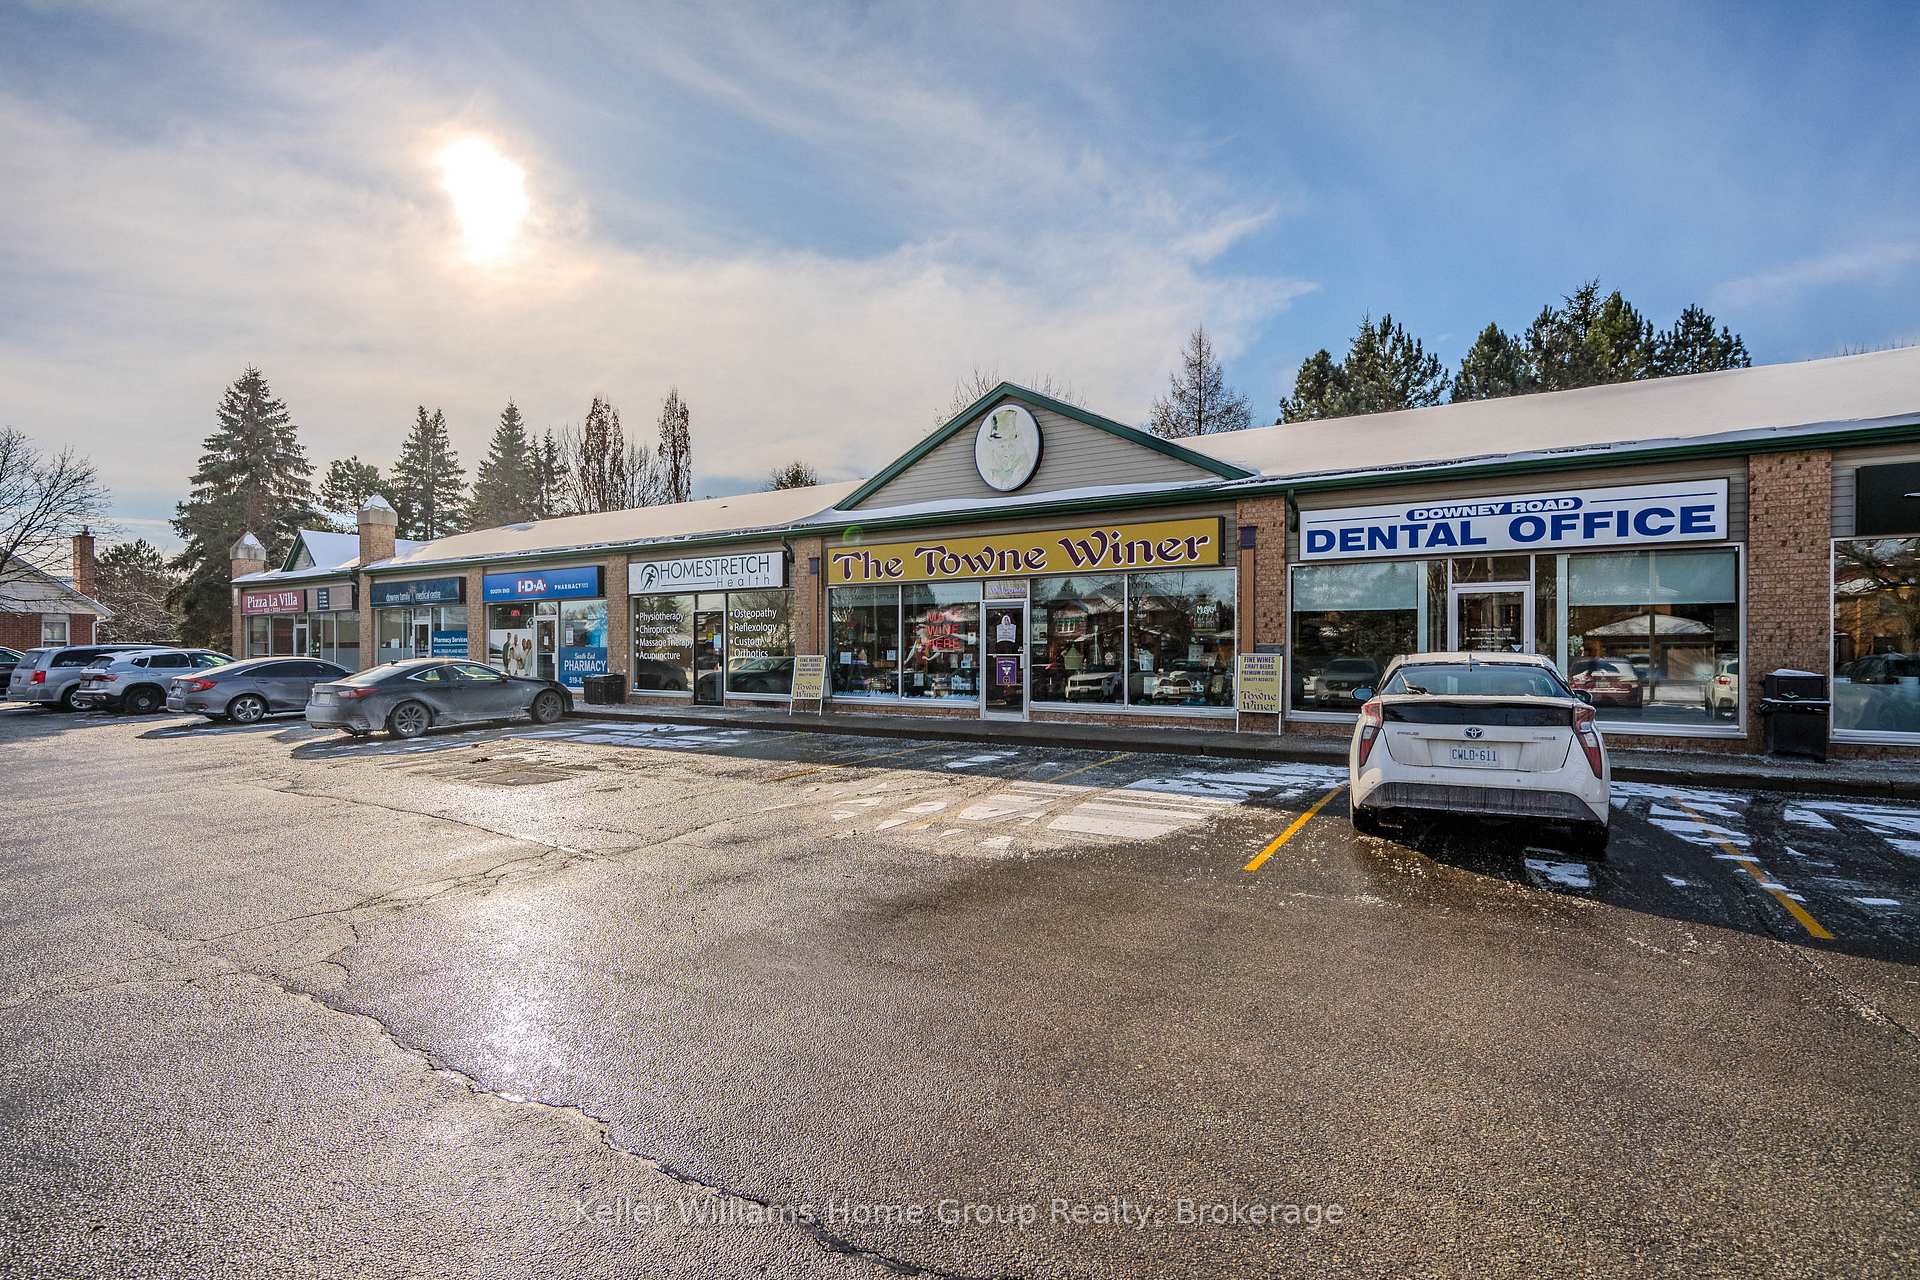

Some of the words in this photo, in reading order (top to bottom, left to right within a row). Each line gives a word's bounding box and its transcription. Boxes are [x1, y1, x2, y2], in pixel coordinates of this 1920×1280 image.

[1413, 503, 1505, 521] DOWNEY
[1510, 497, 1576, 515] ROAD
[1306, 521, 1486, 554] DENTAL
[1508, 505, 1716, 543] OFFICE
[832, 549, 904, 581] The
[913, 544, 1048, 577] Towne
[1057, 529, 1211, 569] Winer
[660, 555, 769, 580] HOMESTRETCH
[716, 574, 770, 588] Health
[247, 596, 267, 608] Pizza
[269, 594, 278, 607] La
[279, 592, 298, 606] Villa
[639, 612, 685, 623] Physiotherapy
[733, 607, 777, 619] Osteopathy
[639, 625, 678, 635] Chiropractic
[734, 622, 778, 633] Reflexology
[928, 623, 960, 635] WINE
[639, 638, 667, 649] Massage
[668, 638, 694, 649] Therapy
[734, 636, 764, 646] Custom
[639, 651, 681, 661] Acupuncture
[734, 648, 769, 657] Orthotics
[564, 659, 607, 672] PHARMACY
[796, 683, 822, 691] Towne
[1240, 690, 1277, 701] Towne
[1242, 700, 1276, 711] Winer
[1479, 750, 1497, 762] 611
